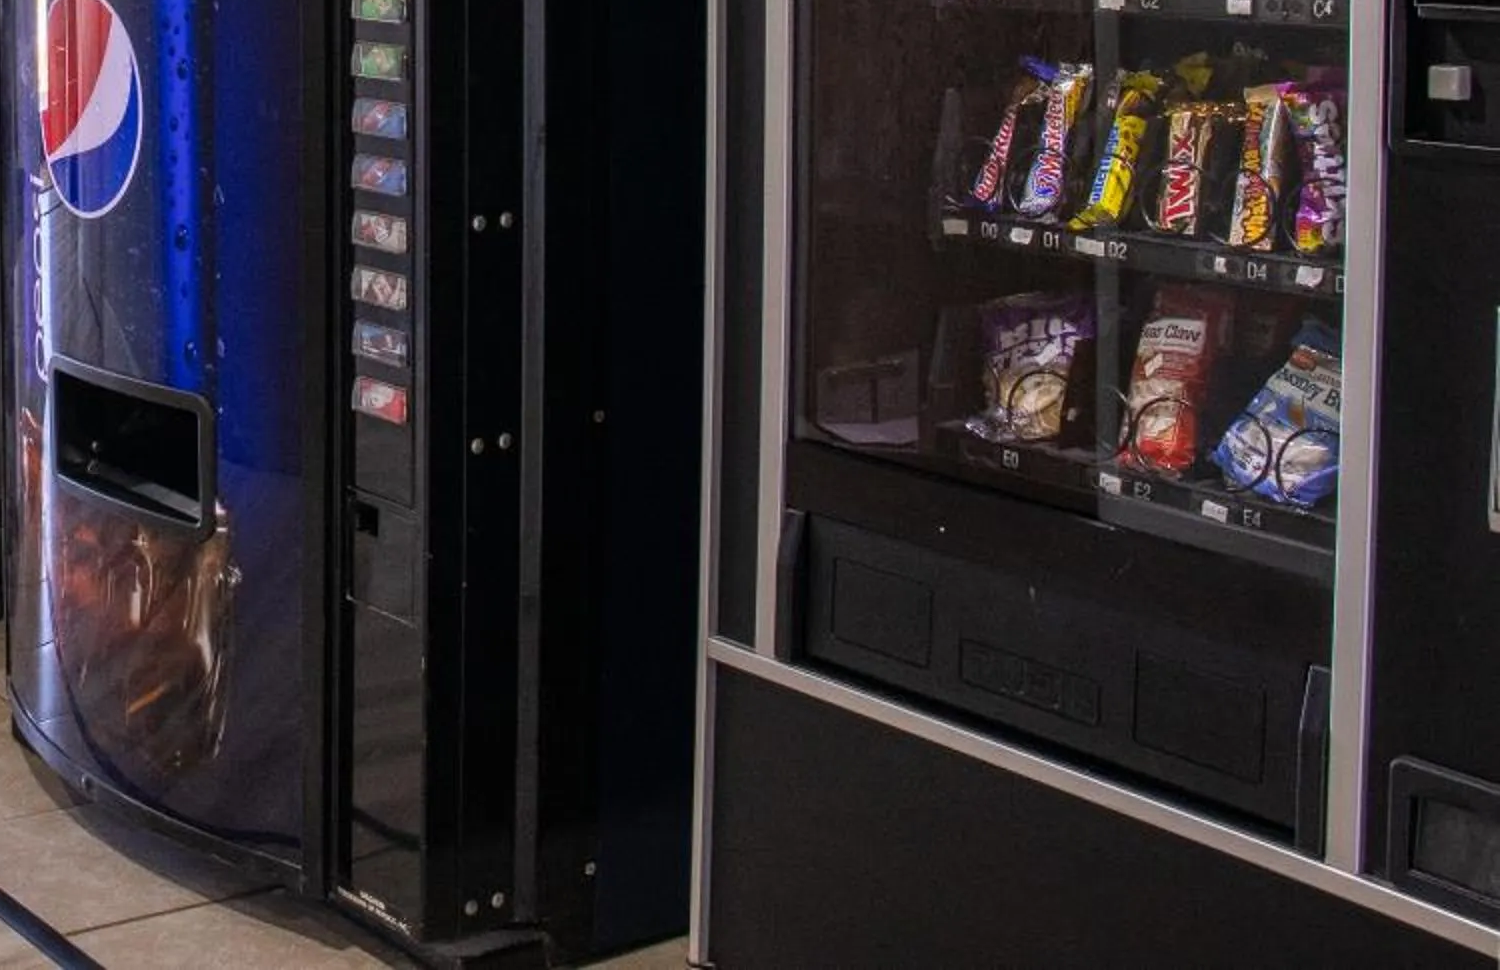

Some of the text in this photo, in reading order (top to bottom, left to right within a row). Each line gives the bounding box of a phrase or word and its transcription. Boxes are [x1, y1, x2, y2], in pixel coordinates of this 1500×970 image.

[1313, 0, 1333, 17] C4
[1247, 261, 1268, 281] D4
[1003, 449, 1019, 469] E0
[1134, 480, 1151, 500] E2
[1243, 508, 1261, 528] E4
